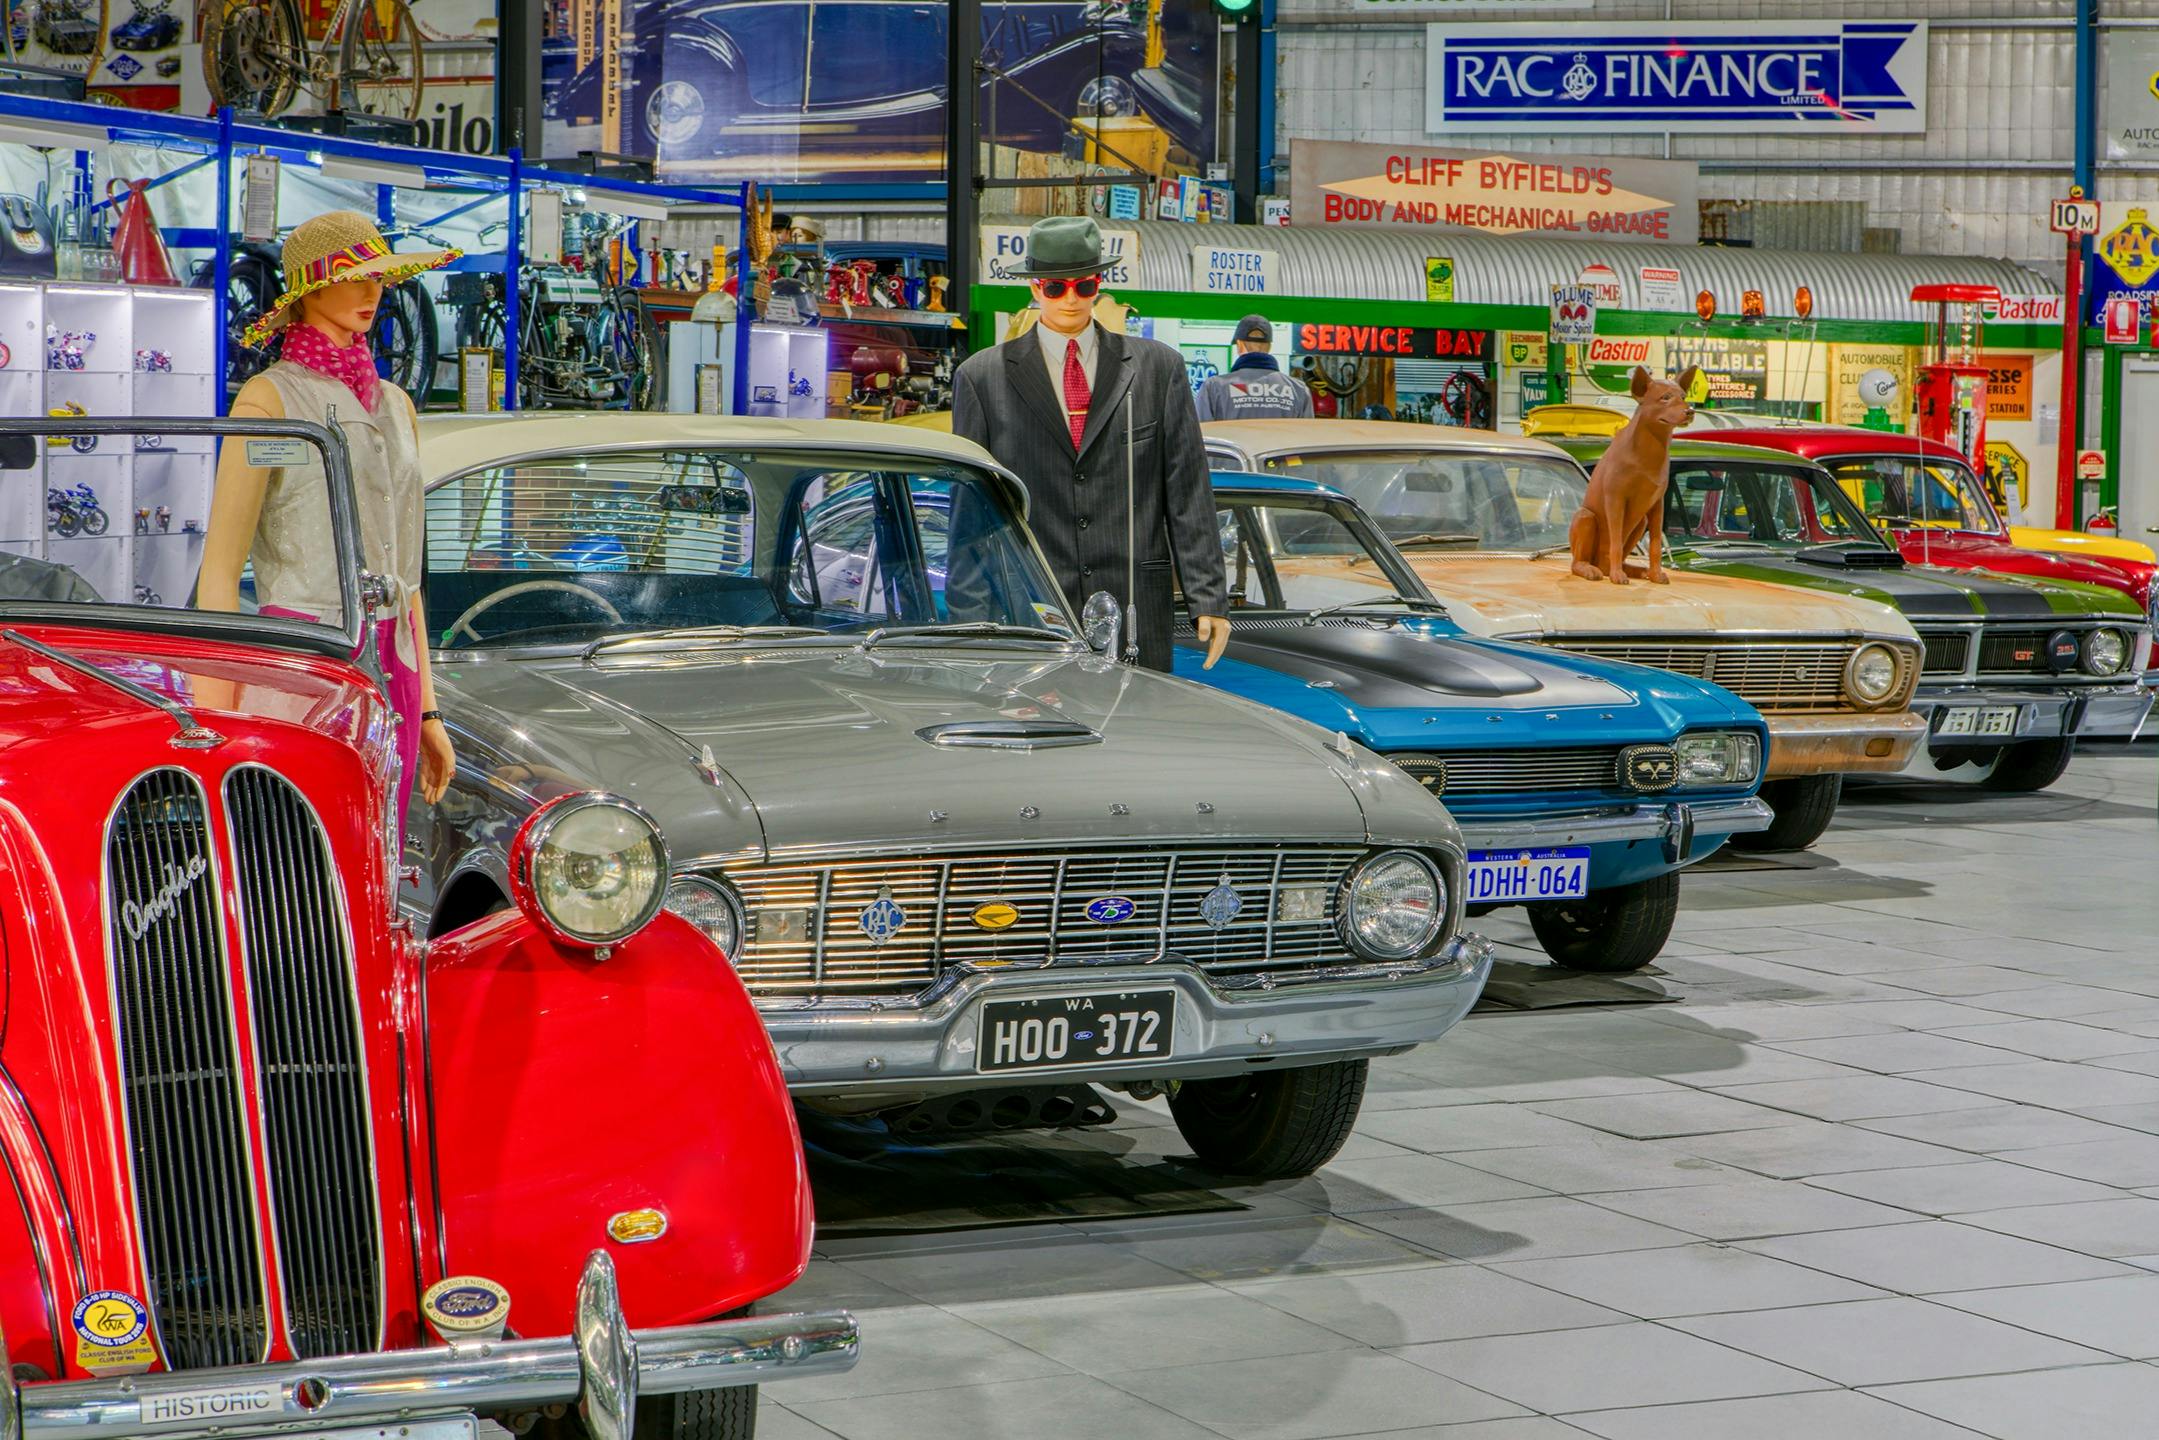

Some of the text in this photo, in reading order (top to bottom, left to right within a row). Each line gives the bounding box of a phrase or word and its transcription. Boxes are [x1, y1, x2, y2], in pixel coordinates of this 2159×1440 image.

[584, 11, 592, 67] BRADBUR
[1456, 53, 1825, 99] RAC RAC FINANCE
[1781, 96, 1825, 105] LIMITED
[2123, 128, 2159, 140] AUTO
[1386, 156, 1613, 195] CLIFF BYFIELD'S
[1269, 207, 1291, 217] PEN
[1325, 194, 1670, 240] BODY AND MECHANICAL GARAGE
[1211, 251, 1262, 272] ROSTER
[1208, 272, 1265, 292] STATION
[1644, 271, 1677, 281] WARNING
[1553, 287, 1594, 308] PLUME
[1999, 298, 2060, 320] Castrol
[1301, 323, 1486, 357] SERVICE BAY
[1514, 347, 1527, 358] BP
[1590, 338, 1651, 361] Castrol
[1667, 352, 1766, 371] AVAILABLE
[1840, 353, 1904, 366] AUTOMOBILE
[1706, 374, 1731, 382] TYRES
[1840, 373, 1863, 385] CLU
[1990, 368, 2022, 384] sse
[1247, 383, 1295, 400] OKA
[1523, 387, 1547, 402] VALV
[1710, 391, 1756, 400] ACCESSORIES
[1987, 386, 2016, 395] ERIES
[1990, 403, 2025, 414] STATION
[2015, 650, 2033, 661] GT
[181, 729, 217, 740] Ford
[867, 901, 900, 933] RAC
[1099, 905, 1122, 919] 75
[1065, 999, 1094, 1011] WA
[1096, 1011, 1161, 1056] 372
[429, 1279, 502, 1299] CLASSIC ENGLISH
[111, 1292, 145, 1315] SIDEVALVE
[441, 1292, 493, 1313] Ford
[103, 1321, 127, 1331] WA
[432, 1312, 455, 1324] CLUB
[78, 1326, 113, 1346] NATIONAL
[114, 1335, 133, 1346] TOUR
[154, 1390, 270, 1418] HISTORIC
